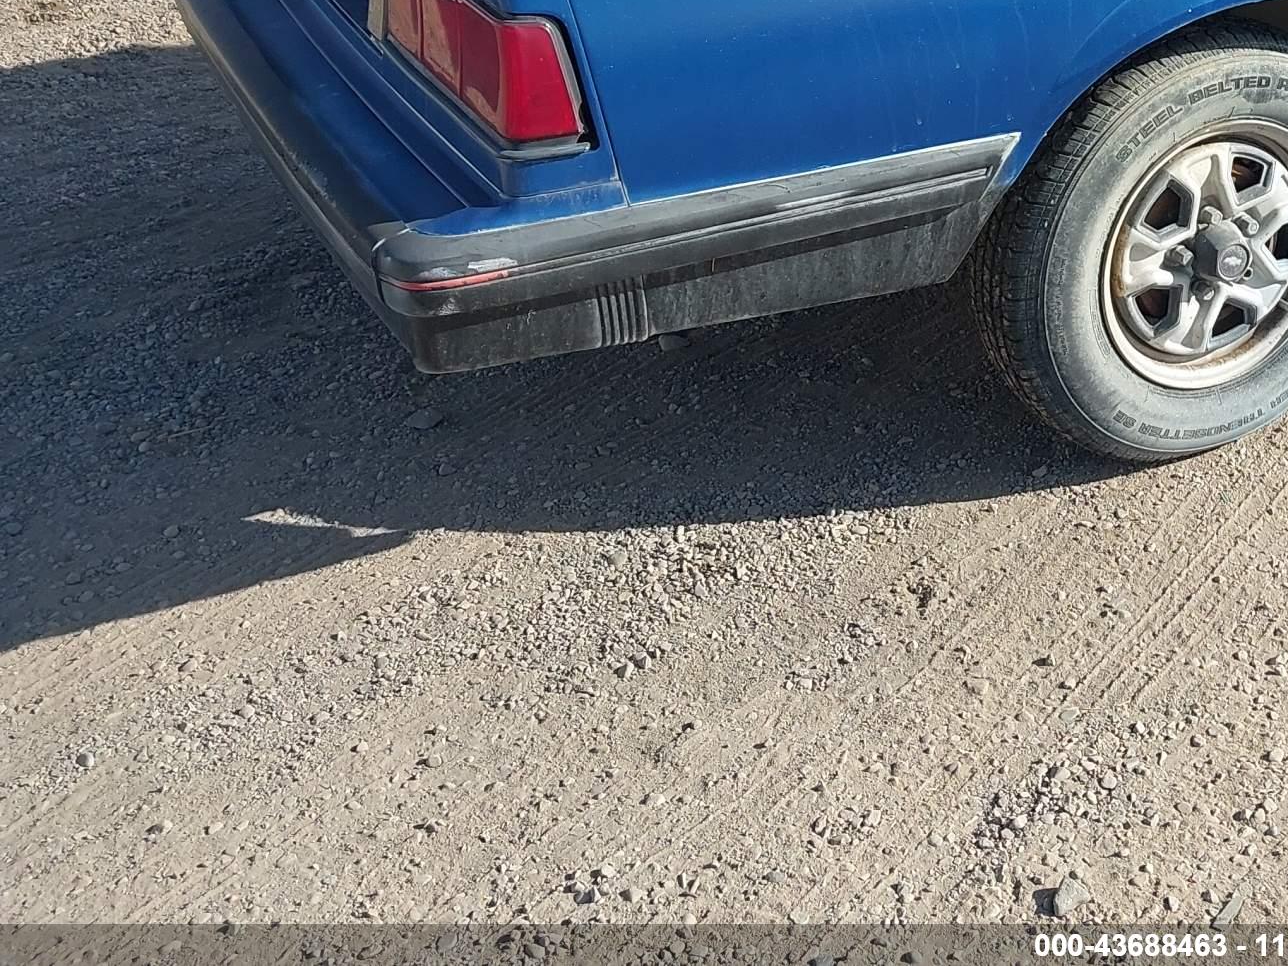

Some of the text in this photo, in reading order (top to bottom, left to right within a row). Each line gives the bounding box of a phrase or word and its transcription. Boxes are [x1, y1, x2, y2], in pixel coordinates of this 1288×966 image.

[1115, 104, 1184, 164] STEEL
[1187, 75, 1271, 106] BELTED
[1112, 409, 1138, 429] SE
